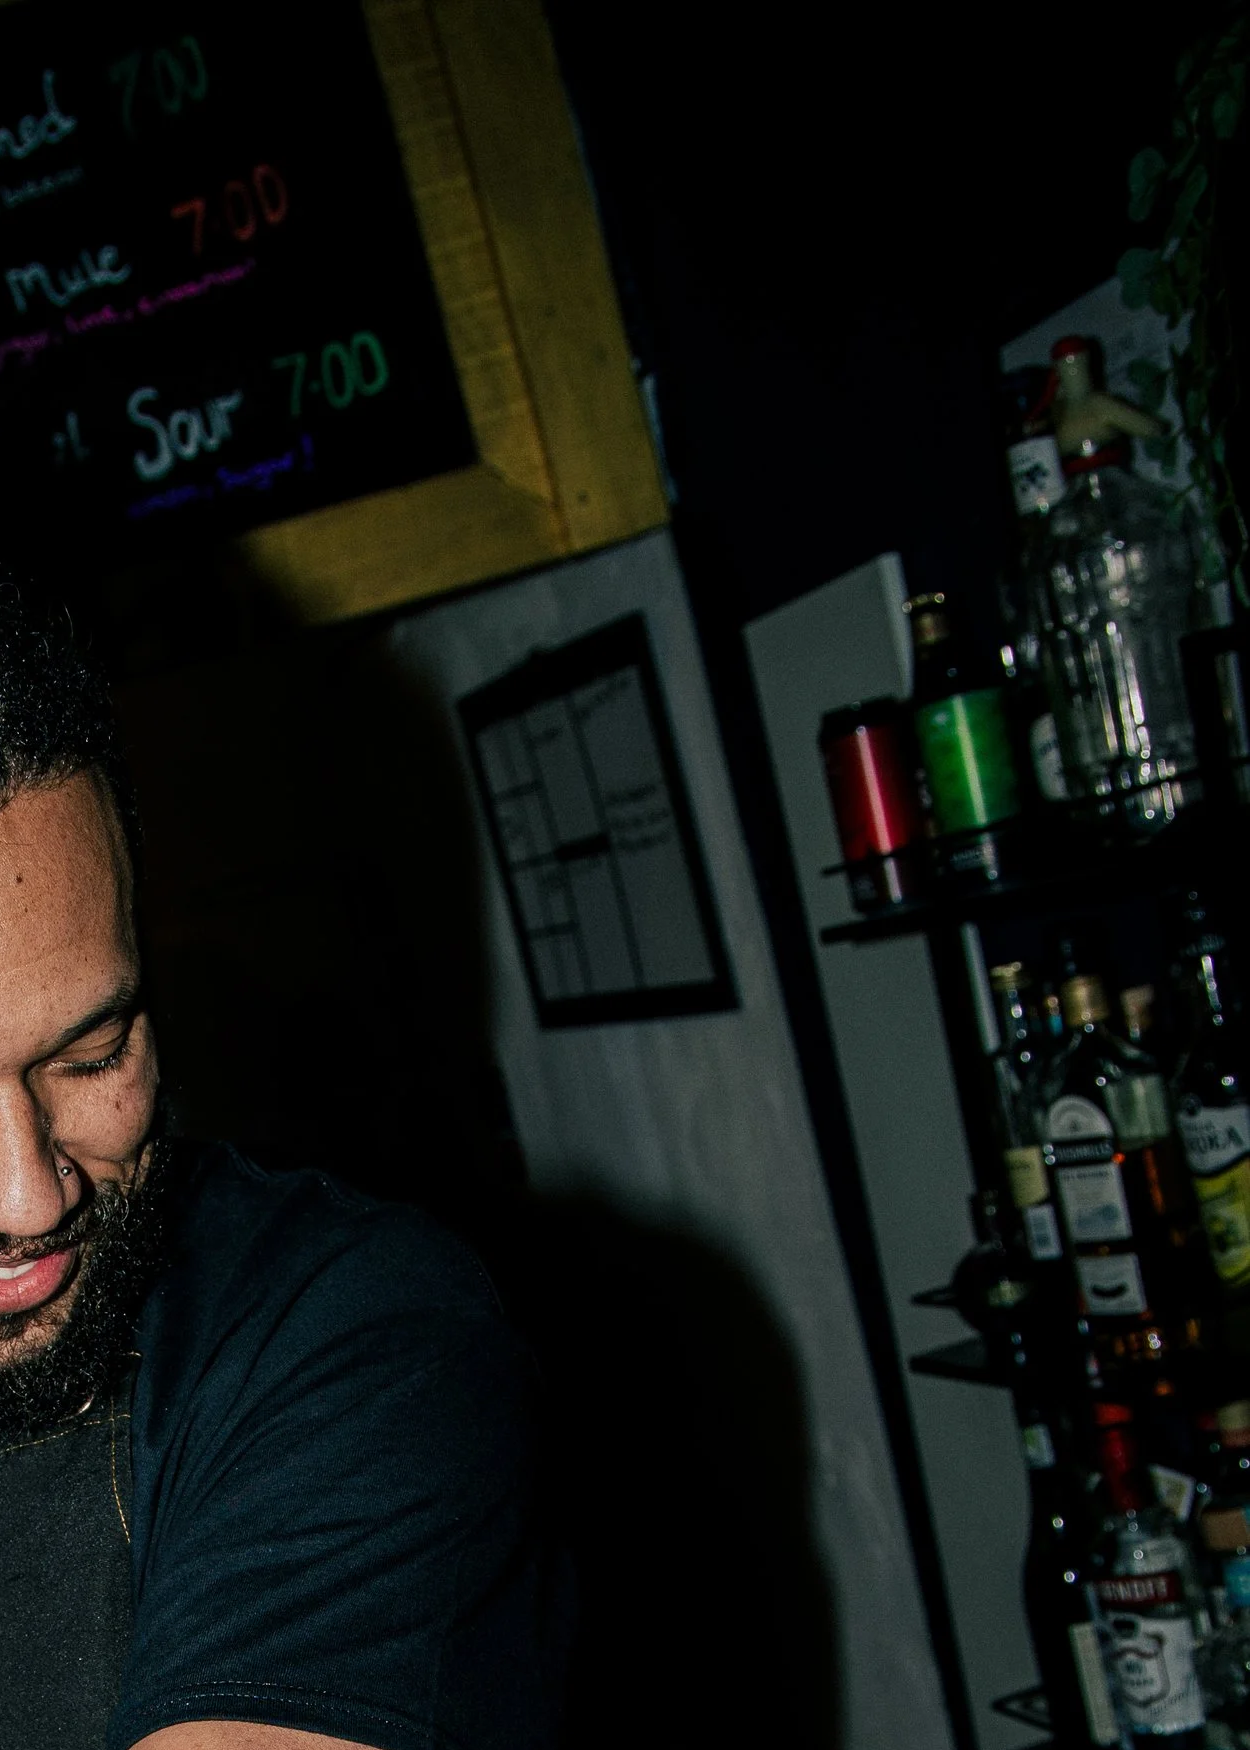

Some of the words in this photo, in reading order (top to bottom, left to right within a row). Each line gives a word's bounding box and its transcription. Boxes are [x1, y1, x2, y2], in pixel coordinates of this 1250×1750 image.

[4, 243, 134, 316] Mule
[126, 385, 244, 481] Sour
[268, 329, 390, 421] 7.00
